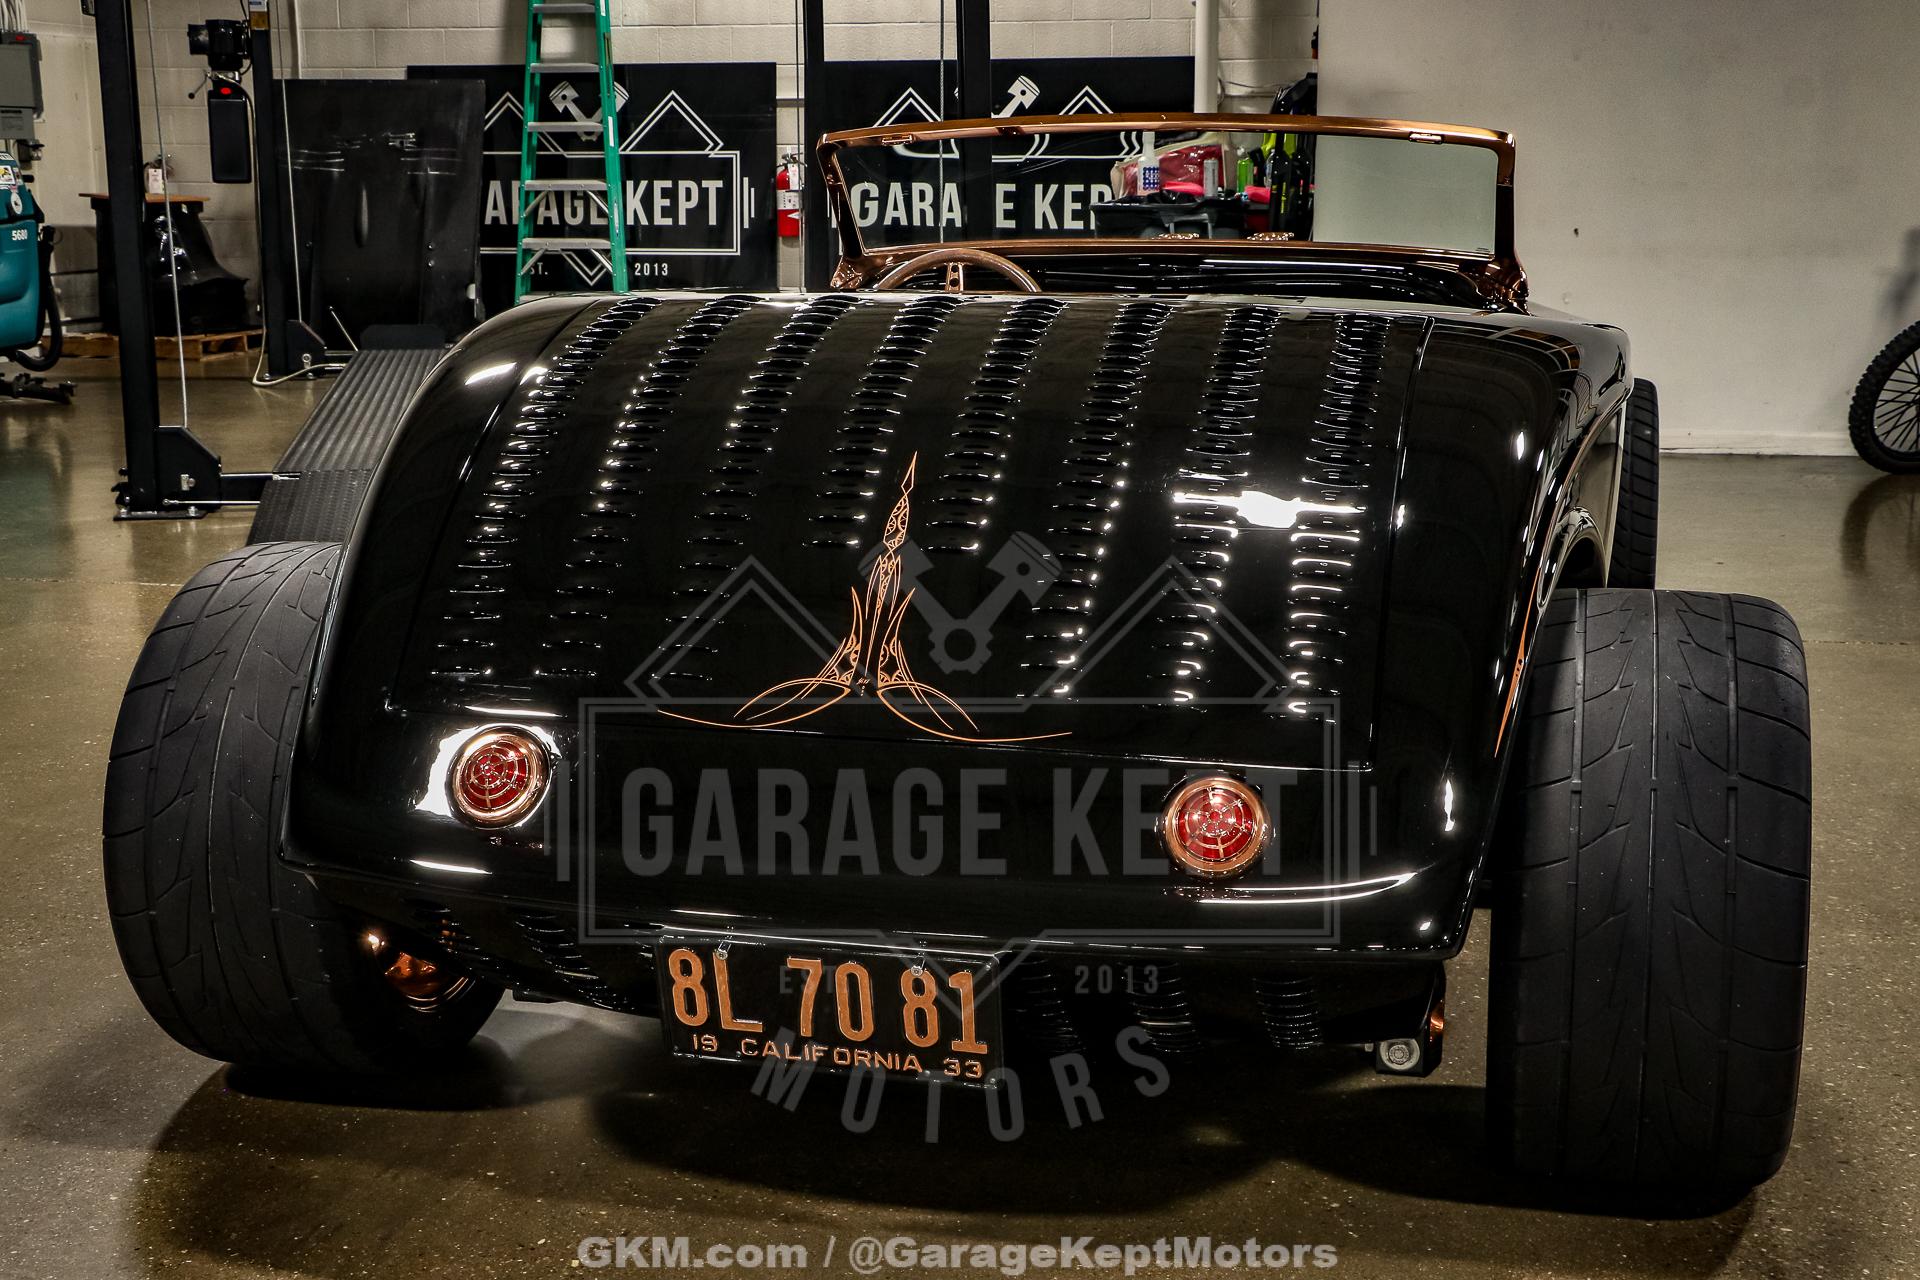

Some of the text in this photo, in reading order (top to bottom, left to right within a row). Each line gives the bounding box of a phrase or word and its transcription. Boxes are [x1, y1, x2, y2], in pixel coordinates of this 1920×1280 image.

[626, 180, 723, 225] KEPT
[851, 182, 1112, 231] GARAE KEP
[634, 263, 668, 276] 2013
[668, 948, 987, 1054] 8L 70 81
[692, 1034, 983, 1079] 19 CALIFORNIA 33
